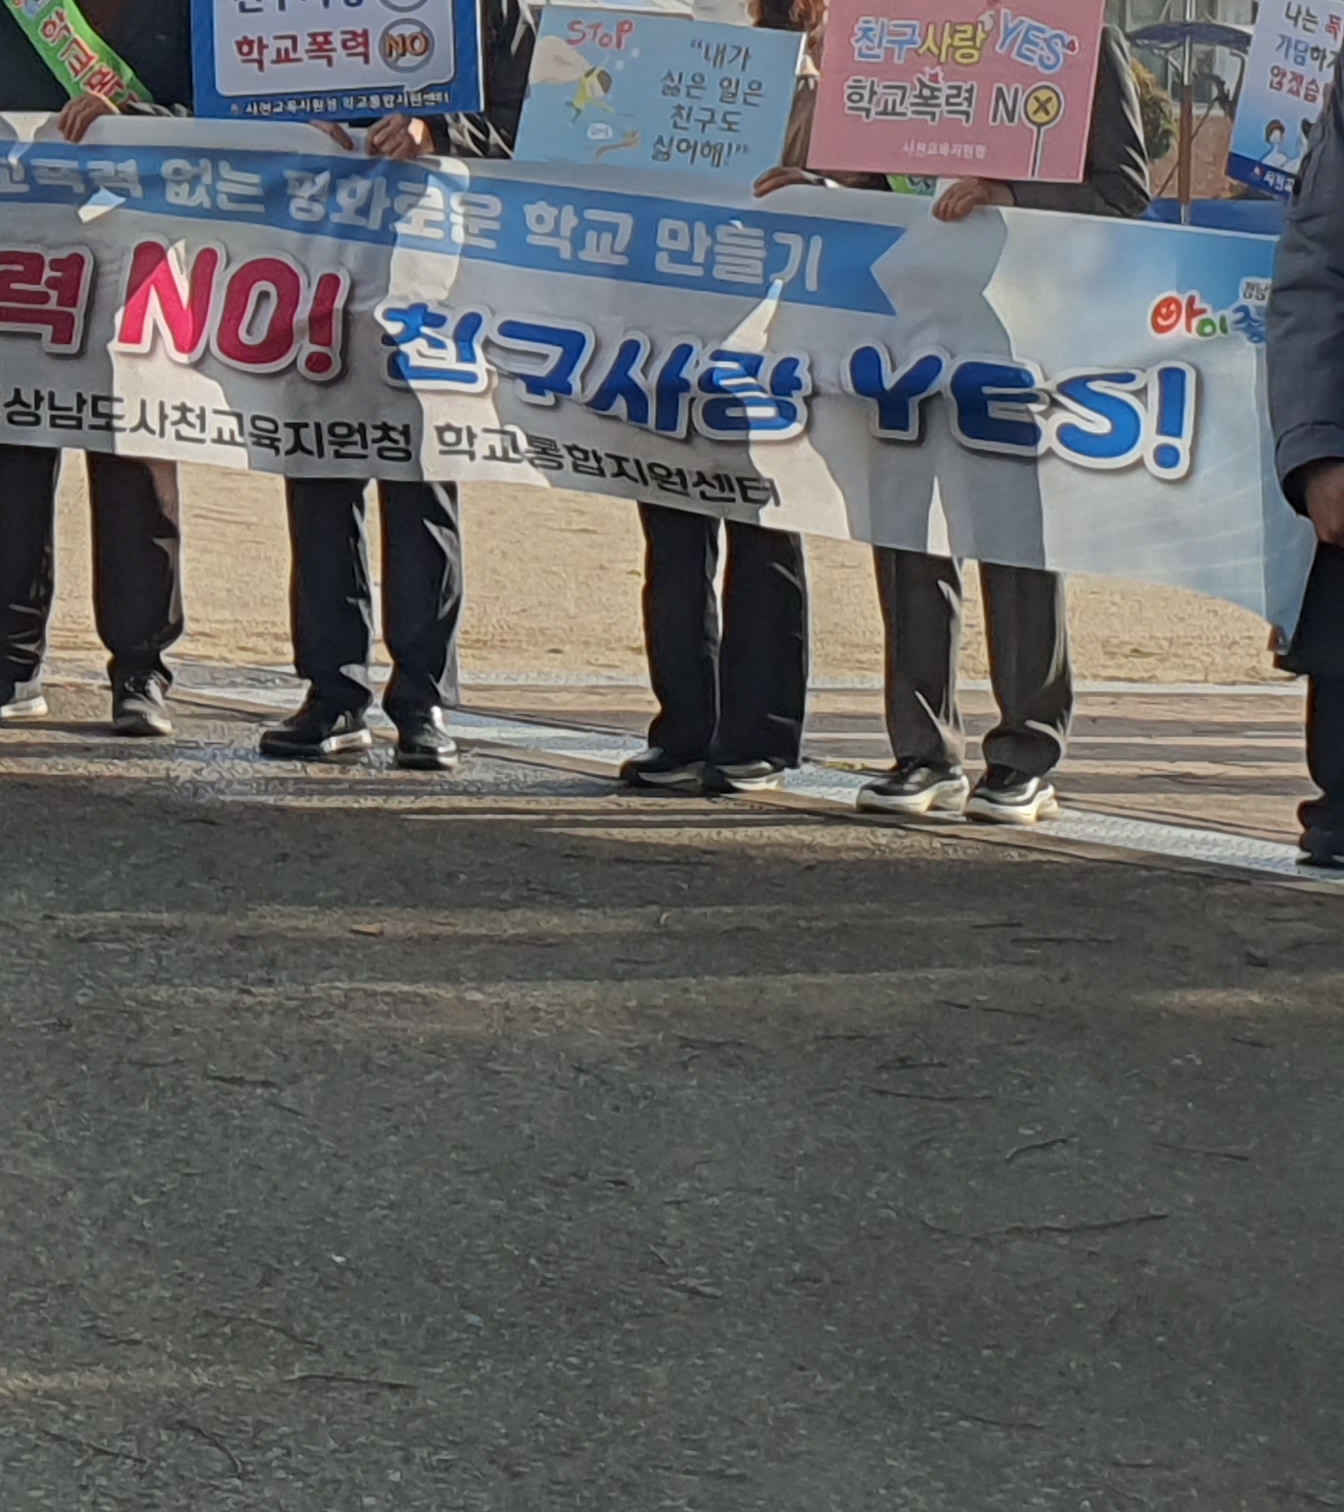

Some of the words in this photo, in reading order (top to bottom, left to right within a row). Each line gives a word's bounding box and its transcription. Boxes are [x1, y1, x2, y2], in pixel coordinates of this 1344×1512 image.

[566, 19, 636, 50] STOP
[853, 16, 987, 64] 친구사랑
[996, 8, 1072, 73] YES
[1284, 0, 1320, 34] 나는
[40, 8, 140, 100] 학교폭
[234, 28, 372, 73] 학교폭력
[384, 31, 430, 59] NO
[660, 70, 708, 100] 싫은
[718, 76, 765, 107] 일은
[845, 76, 976, 125] 학교폭력
[669, 103, 743, 134] 친구도
[161, 158, 266, 213] 없는
[282, 168, 503, 250] 평화로운
[523, 200, 633, 264] 학교
[655, 218, 823, 292] 만들기
[114, 236, 351, 381] NO!
[378, 301, 810, 440] 친구사랑
[845, 339, 1197, 478] YES!
[434, 421, 782, 508] 학교통합지원센터
